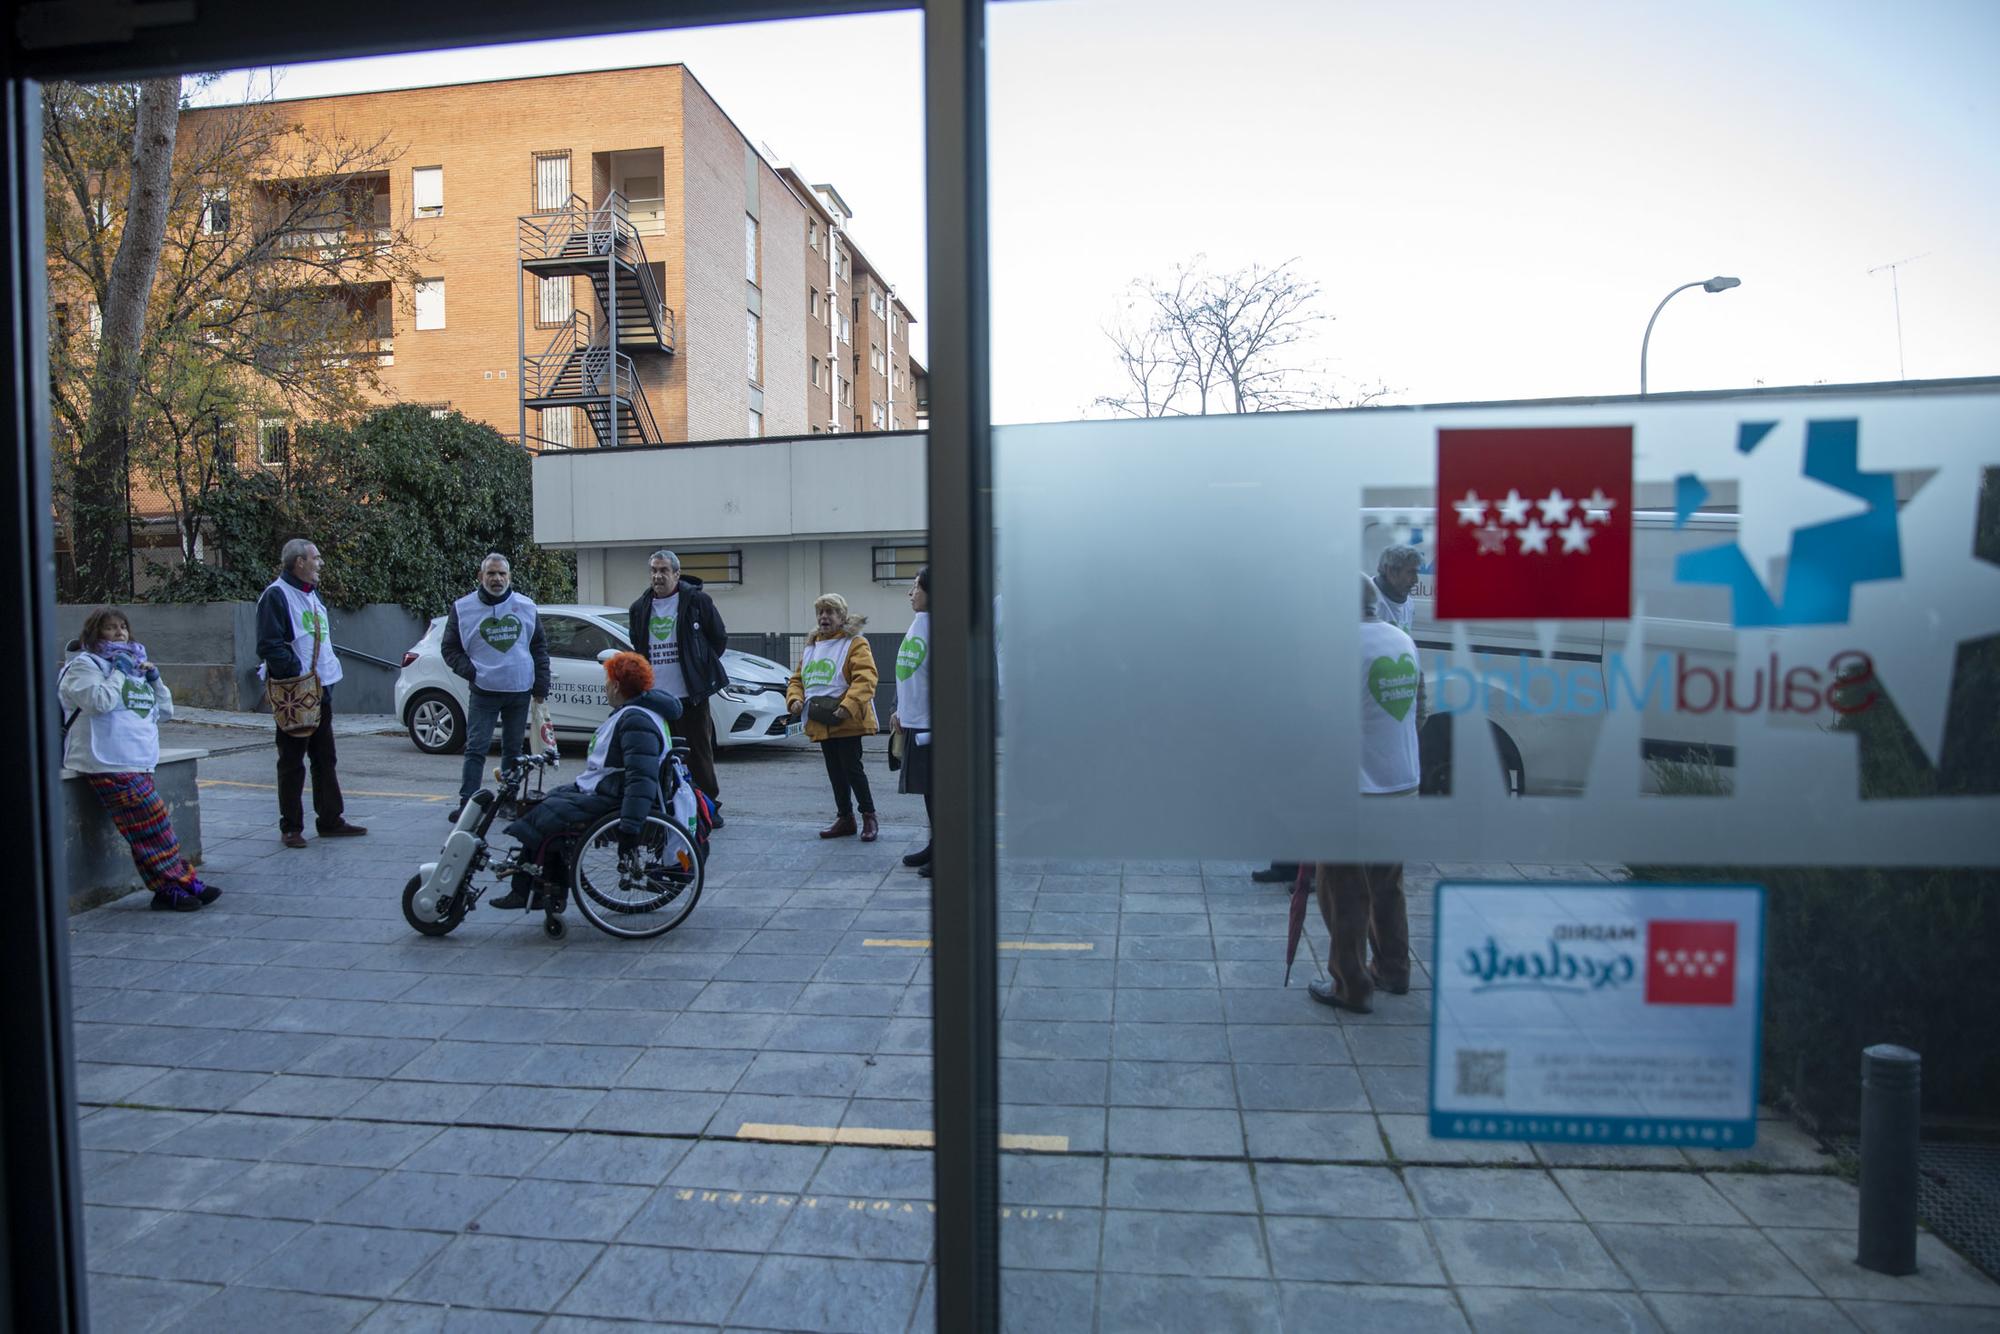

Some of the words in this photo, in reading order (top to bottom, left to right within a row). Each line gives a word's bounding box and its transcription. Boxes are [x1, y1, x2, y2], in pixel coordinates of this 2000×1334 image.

[548, 682, 576, 692] RIETE
[577, 683, 608, 693] SEGUR
[554, 692, 567, 703] 91
[571, 694, 592, 705] 643
